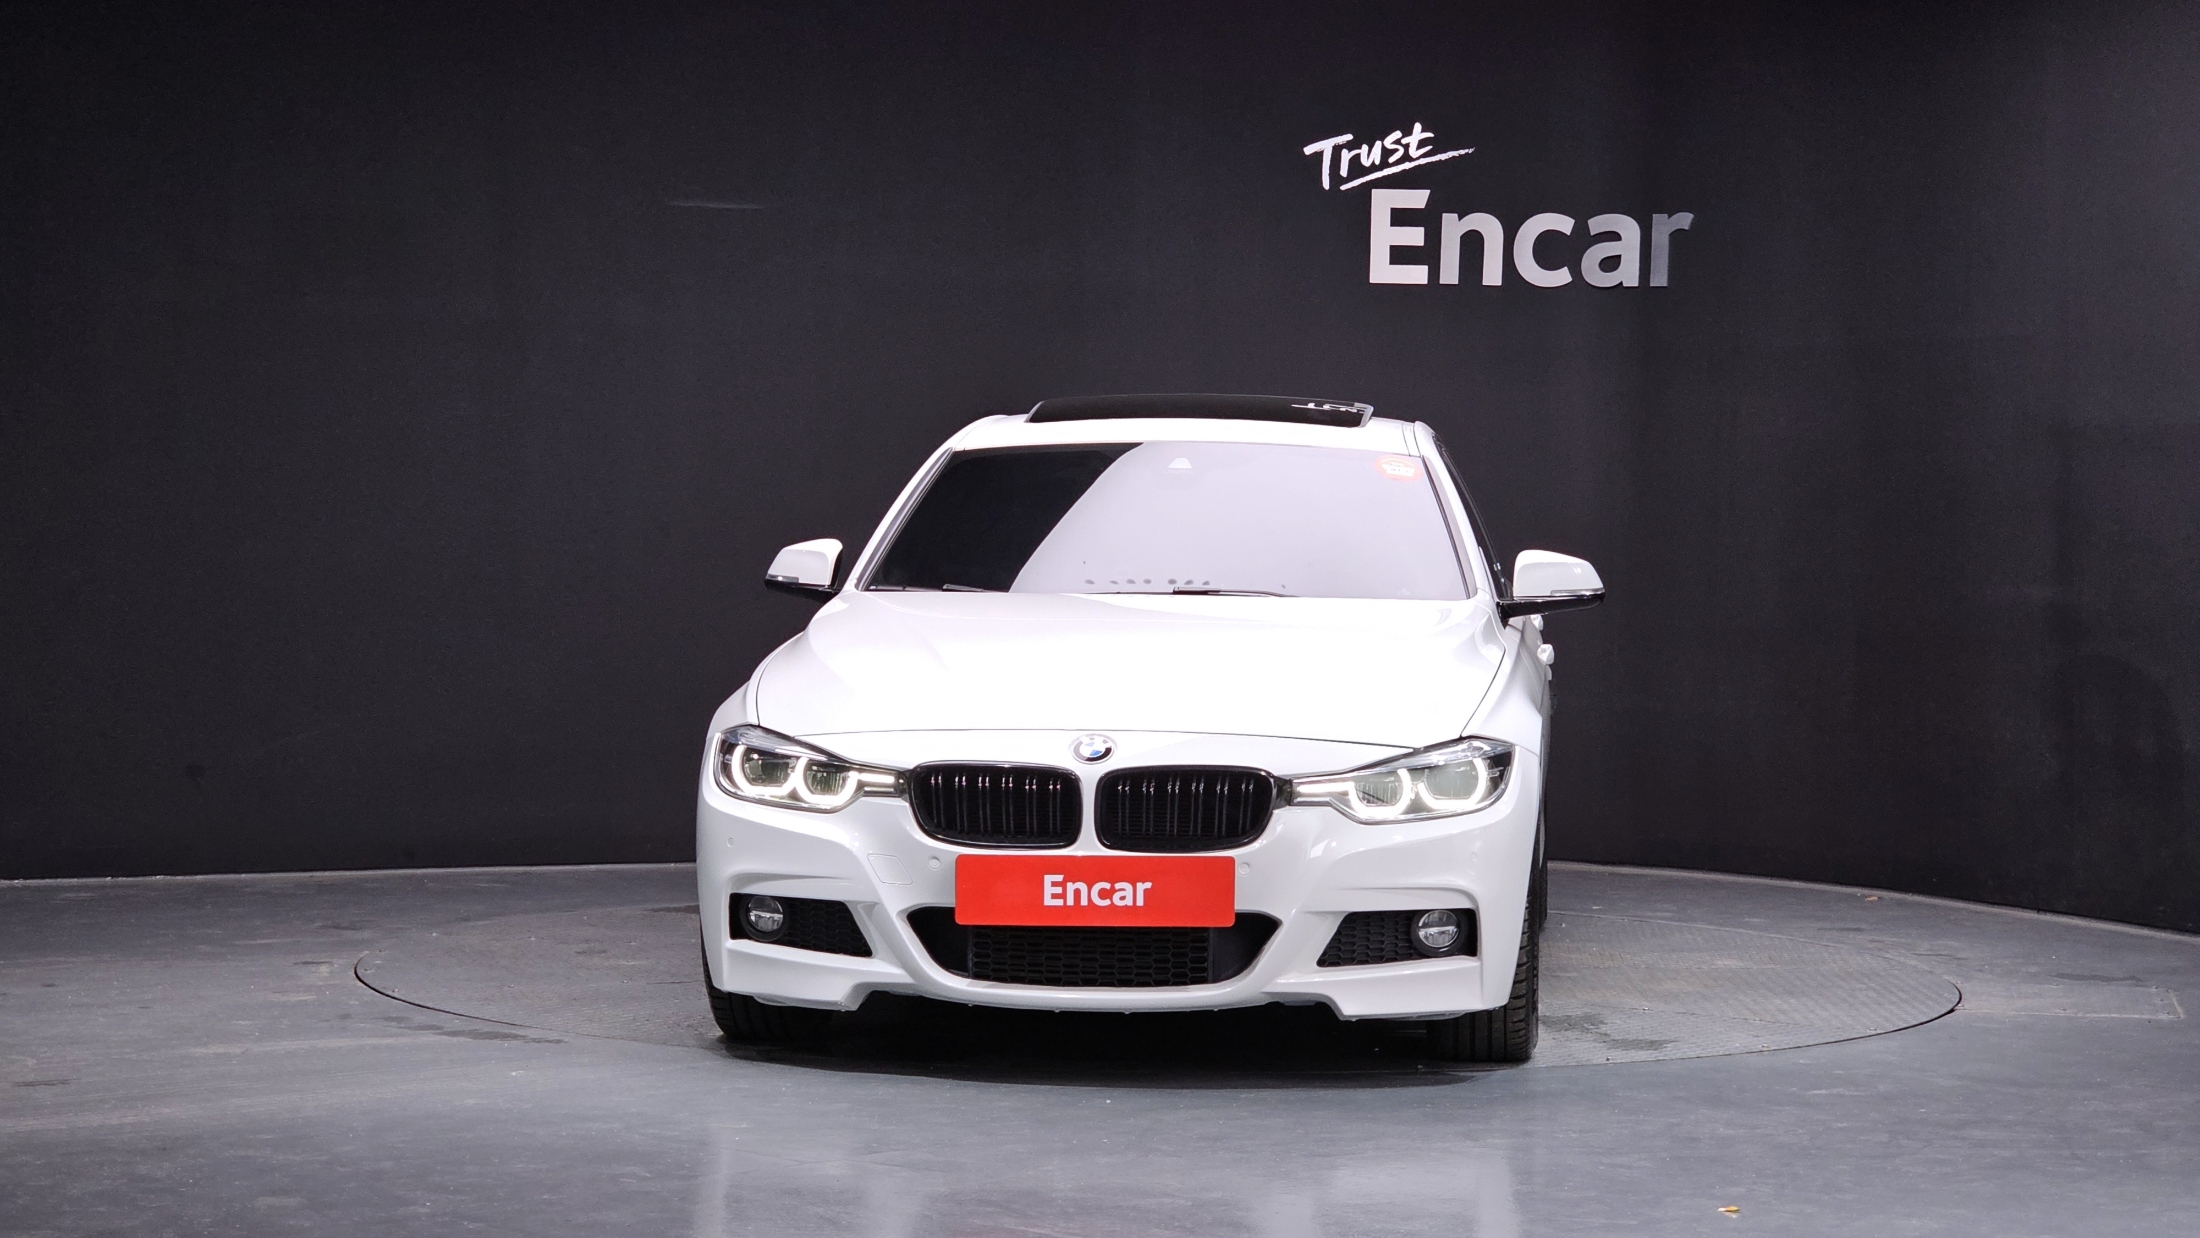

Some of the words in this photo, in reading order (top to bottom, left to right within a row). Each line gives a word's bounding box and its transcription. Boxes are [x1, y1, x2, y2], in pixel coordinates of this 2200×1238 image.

[1303, 122, 1435, 191] Trust
[1369, 188, 1695, 288] Encar
[1043, 874, 1152, 907] Encar
